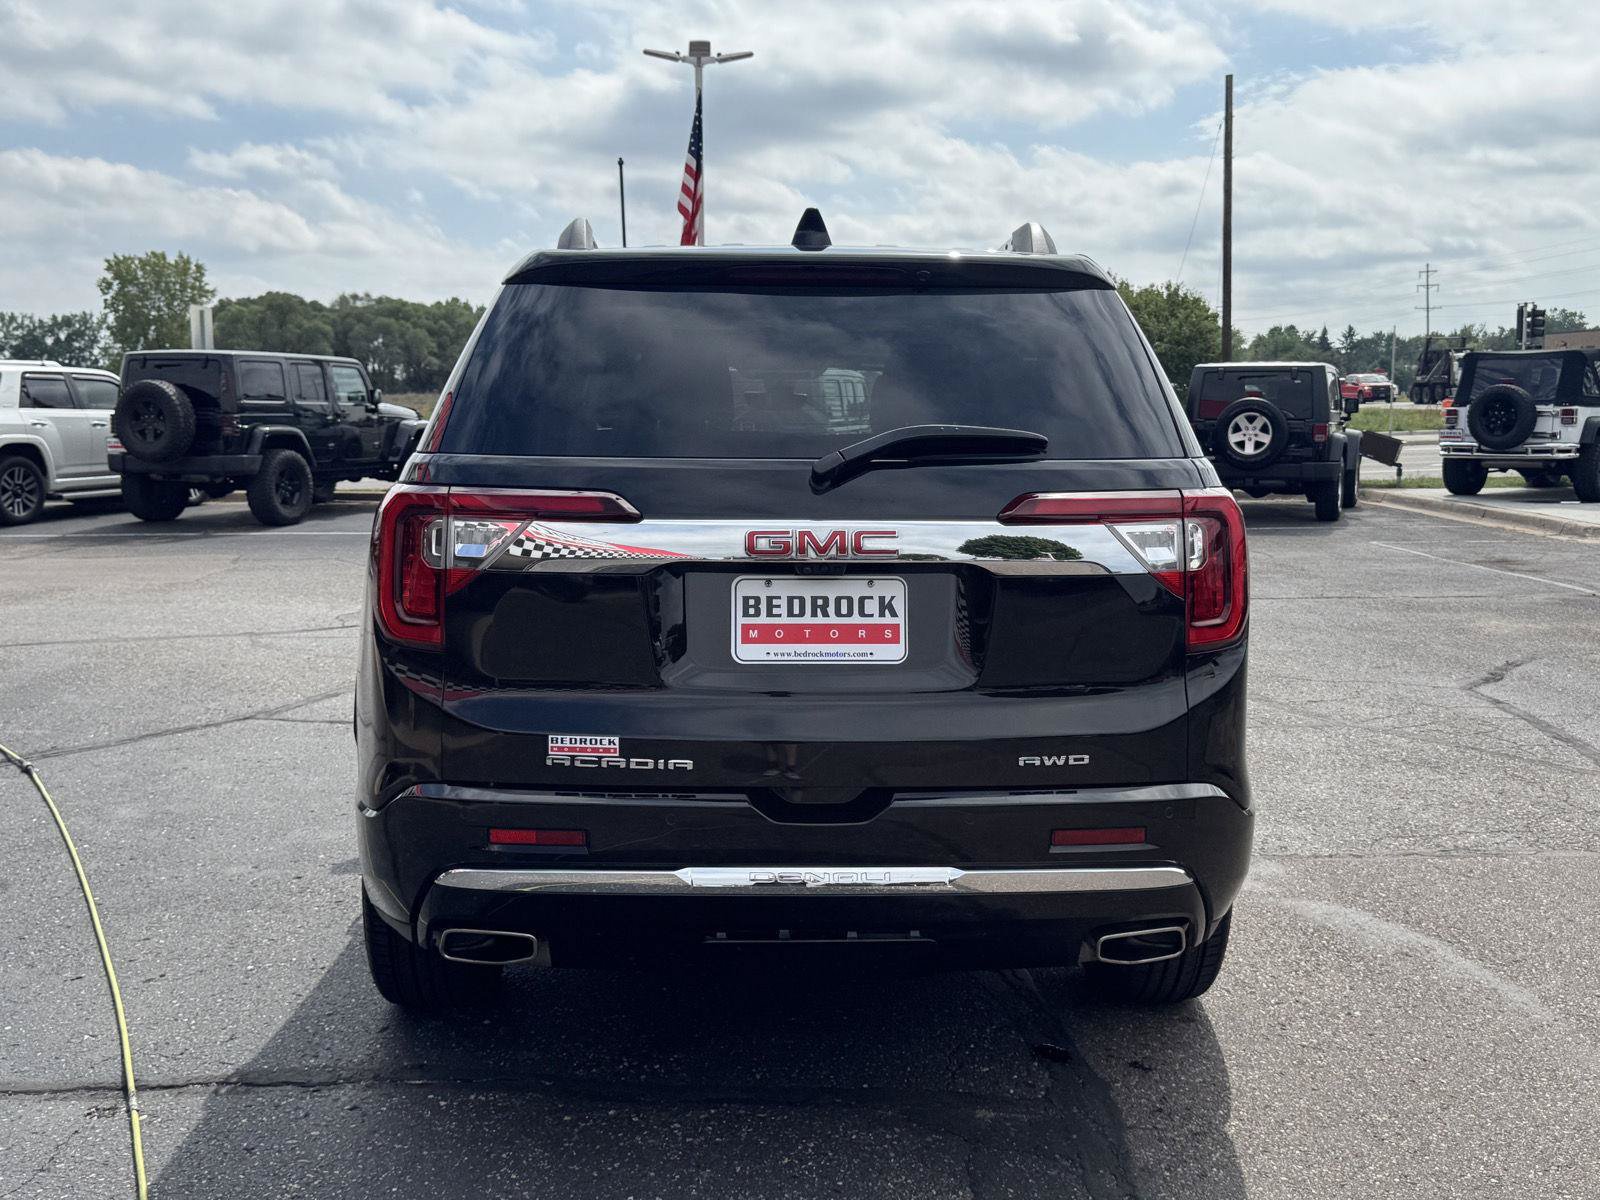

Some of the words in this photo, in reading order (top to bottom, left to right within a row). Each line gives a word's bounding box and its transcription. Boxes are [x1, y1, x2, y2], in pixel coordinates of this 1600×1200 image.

[745, 529, 900, 559] GMC
[741, 595, 899, 618] BEDROCK
[749, 629, 893, 639] MOTORS
[773, 650, 869, 659] www.bedrockmotors.com
[550, 737, 617, 746] BEDROCK
[545, 755, 694, 771] ACADIA
[1018, 754, 1090, 767] AWD
[749, 871, 891, 884] DENALI
